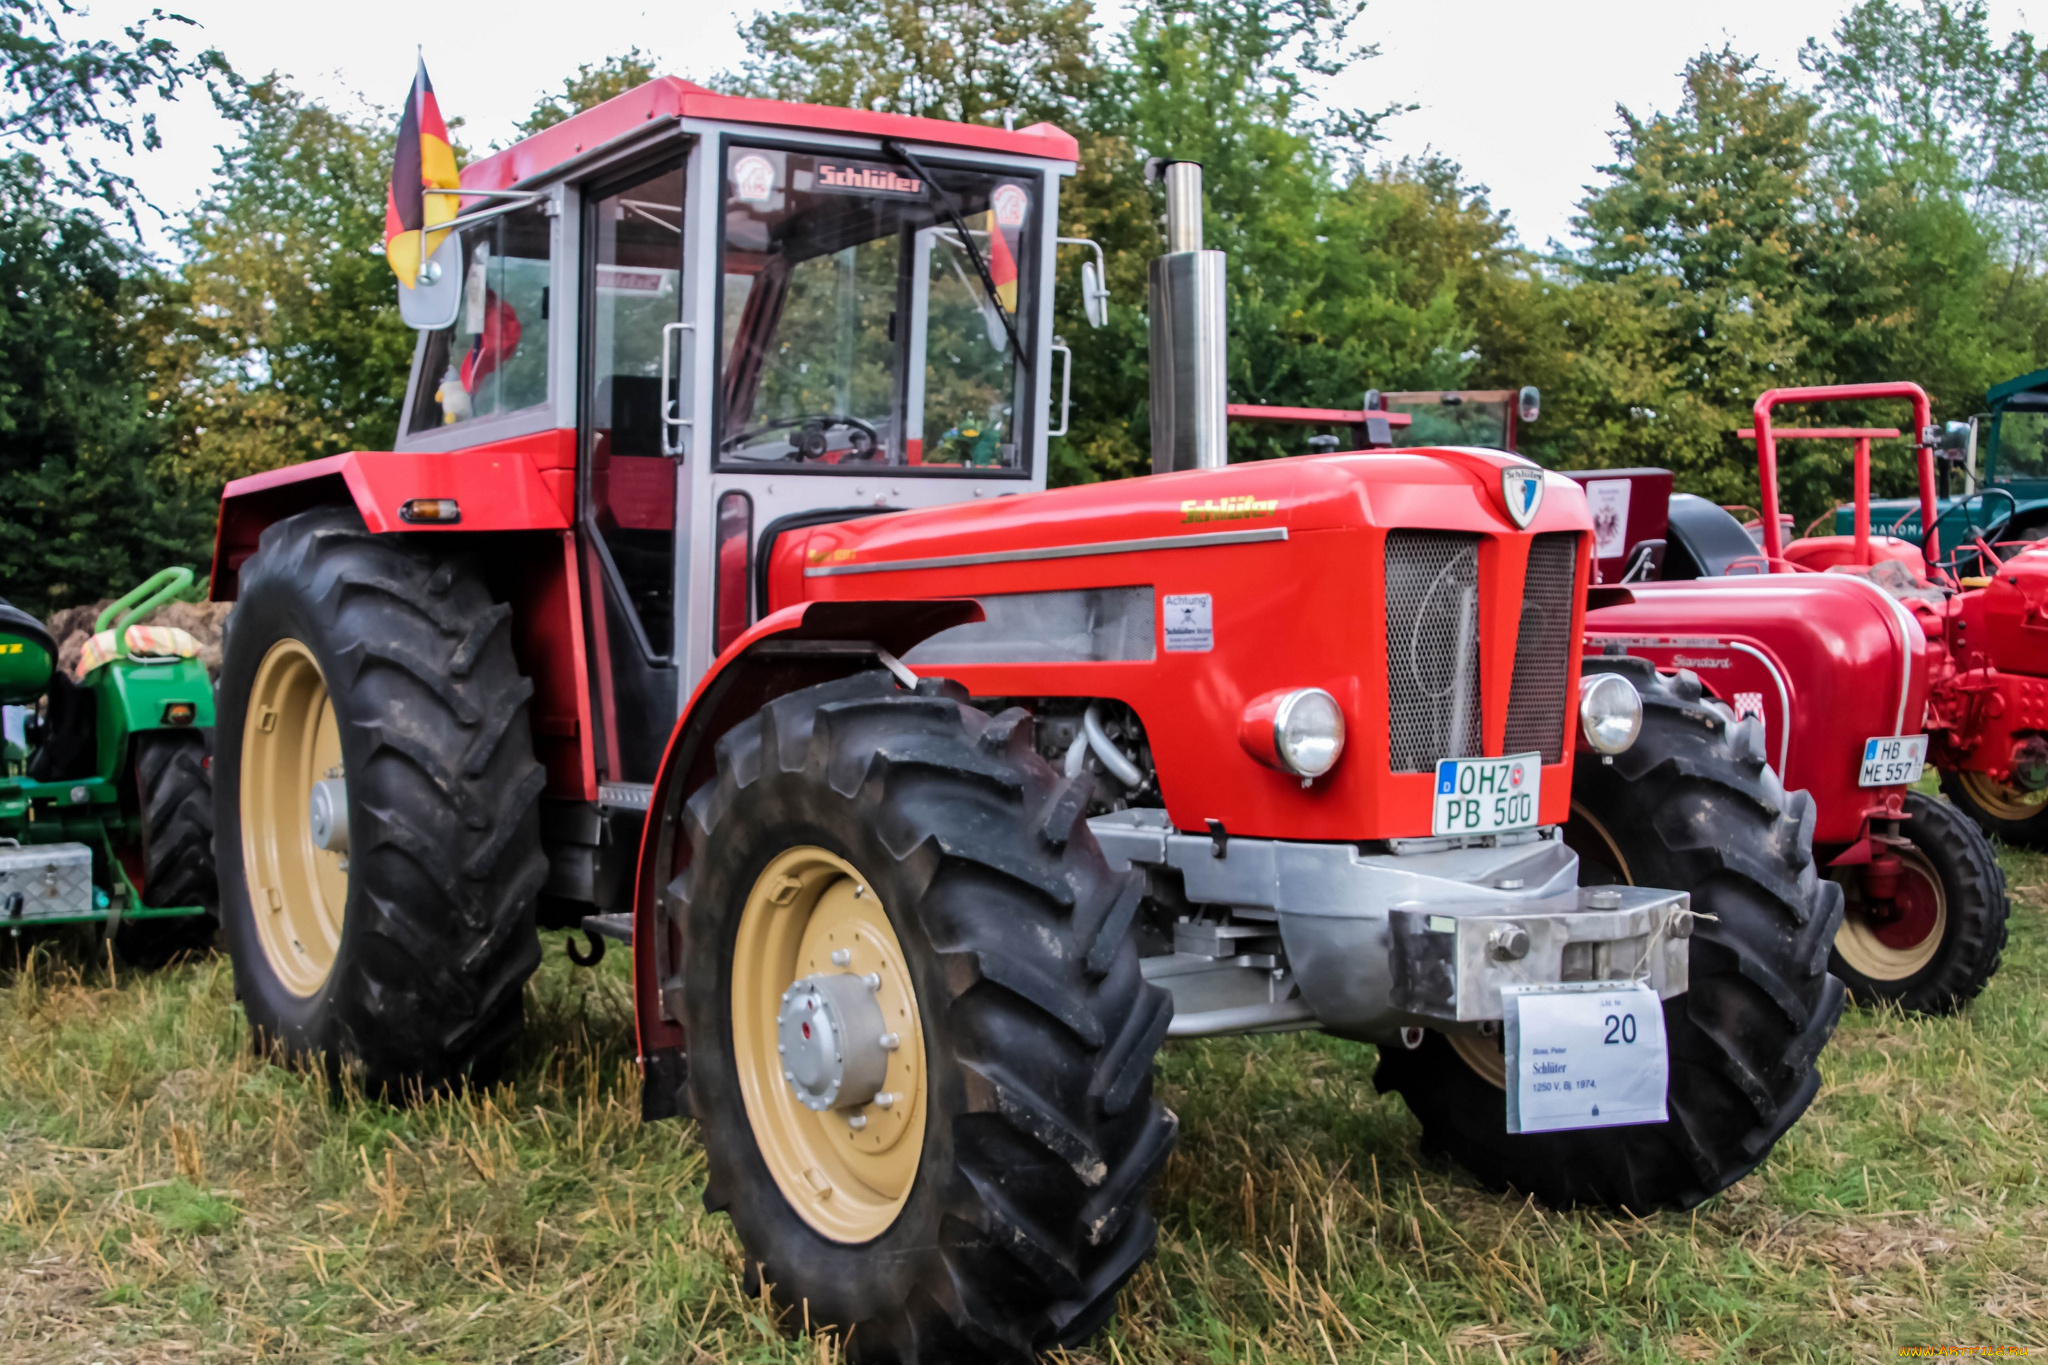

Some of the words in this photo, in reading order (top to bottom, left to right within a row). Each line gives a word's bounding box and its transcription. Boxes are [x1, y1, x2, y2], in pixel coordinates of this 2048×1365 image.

[819, 164, 921, 193] Schlüter
[1180, 494, 1279, 524] Schlüter
[1672, 654, 1732, 669] Standard
[1881, 742, 1900, 760] HB
[1459, 764, 1510, 795] OHZ
[1863, 763, 1883, 783] ME
[1885, 762, 1912, 781] 557
[1447, 799, 1481, 829] PB
[1494, 794, 1531, 826] 500
[1604, 1013, 1637, 1045] 20
[1532, 1061, 1567, 1075] Schlüter
[1533, 1081, 1552, 1092] 1250
